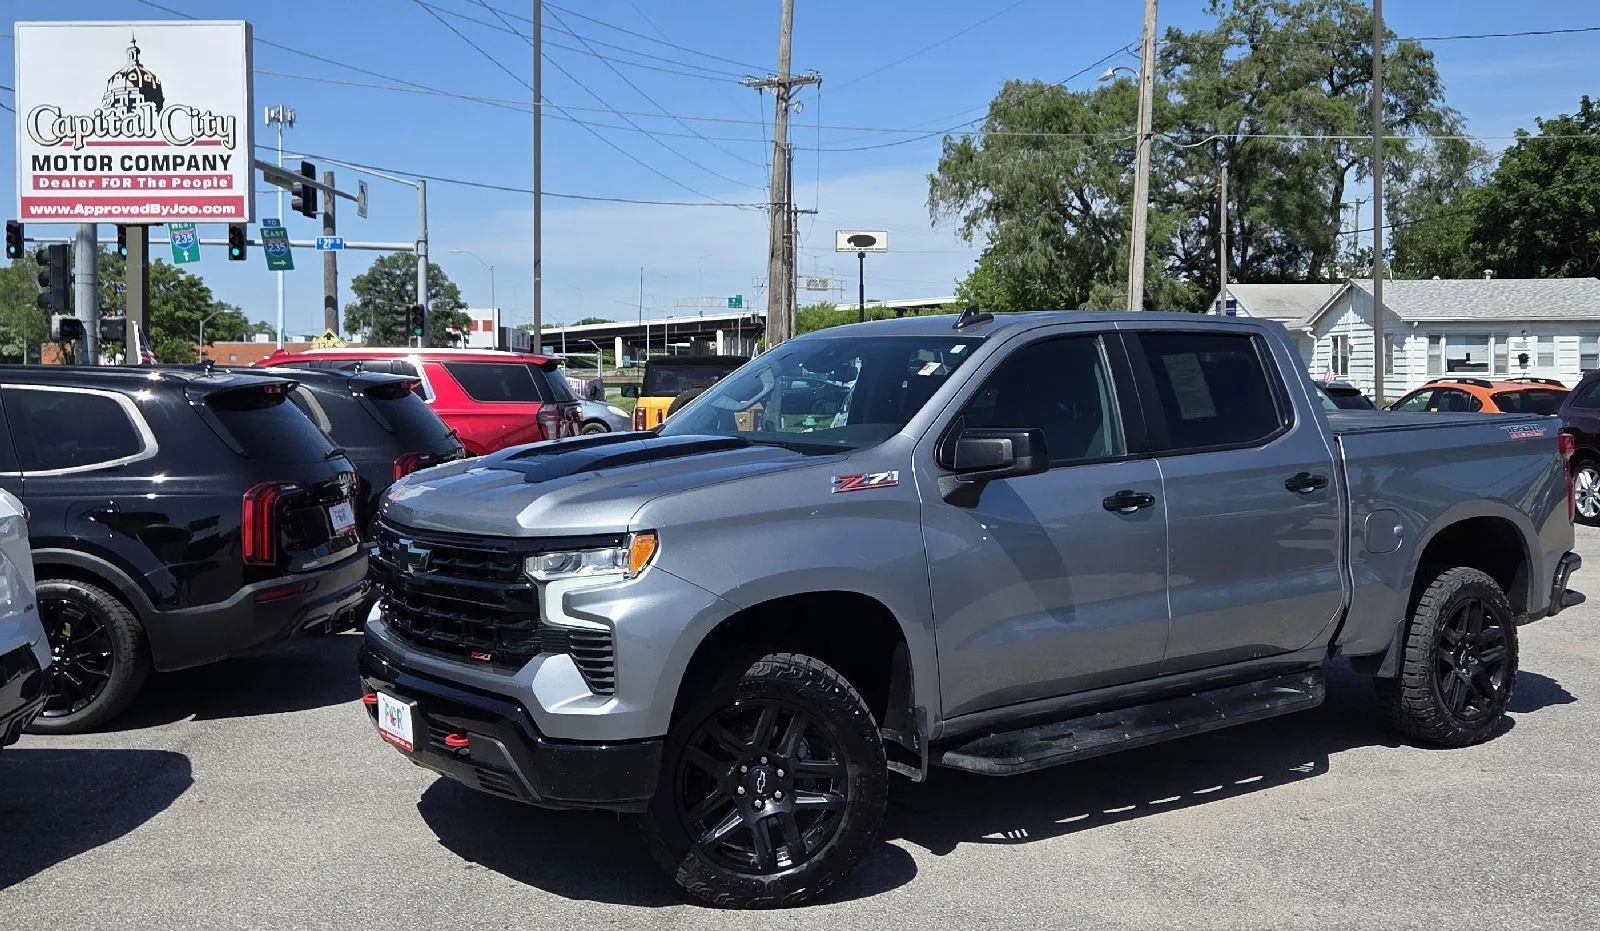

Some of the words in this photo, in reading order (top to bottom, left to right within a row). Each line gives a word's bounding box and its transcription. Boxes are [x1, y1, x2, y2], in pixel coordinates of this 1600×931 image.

[27, 104, 156, 151] Capital
[160, 104, 236, 150] City
[31, 154, 113, 171] MOTOR
[120, 154, 232, 171] COMPANY
[39, 177, 95, 188] Dealer
[101, 177, 132, 188] FOR
[138, 177, 166, 188] The
[171, 176, 228, 189] People
[29, 203, 236, 216] www.ApprovedByJoe.com
[175, 233, 194, 245] 235
[268, 244, 286, 252] 235
[831, 470, 899, 493] Z71
